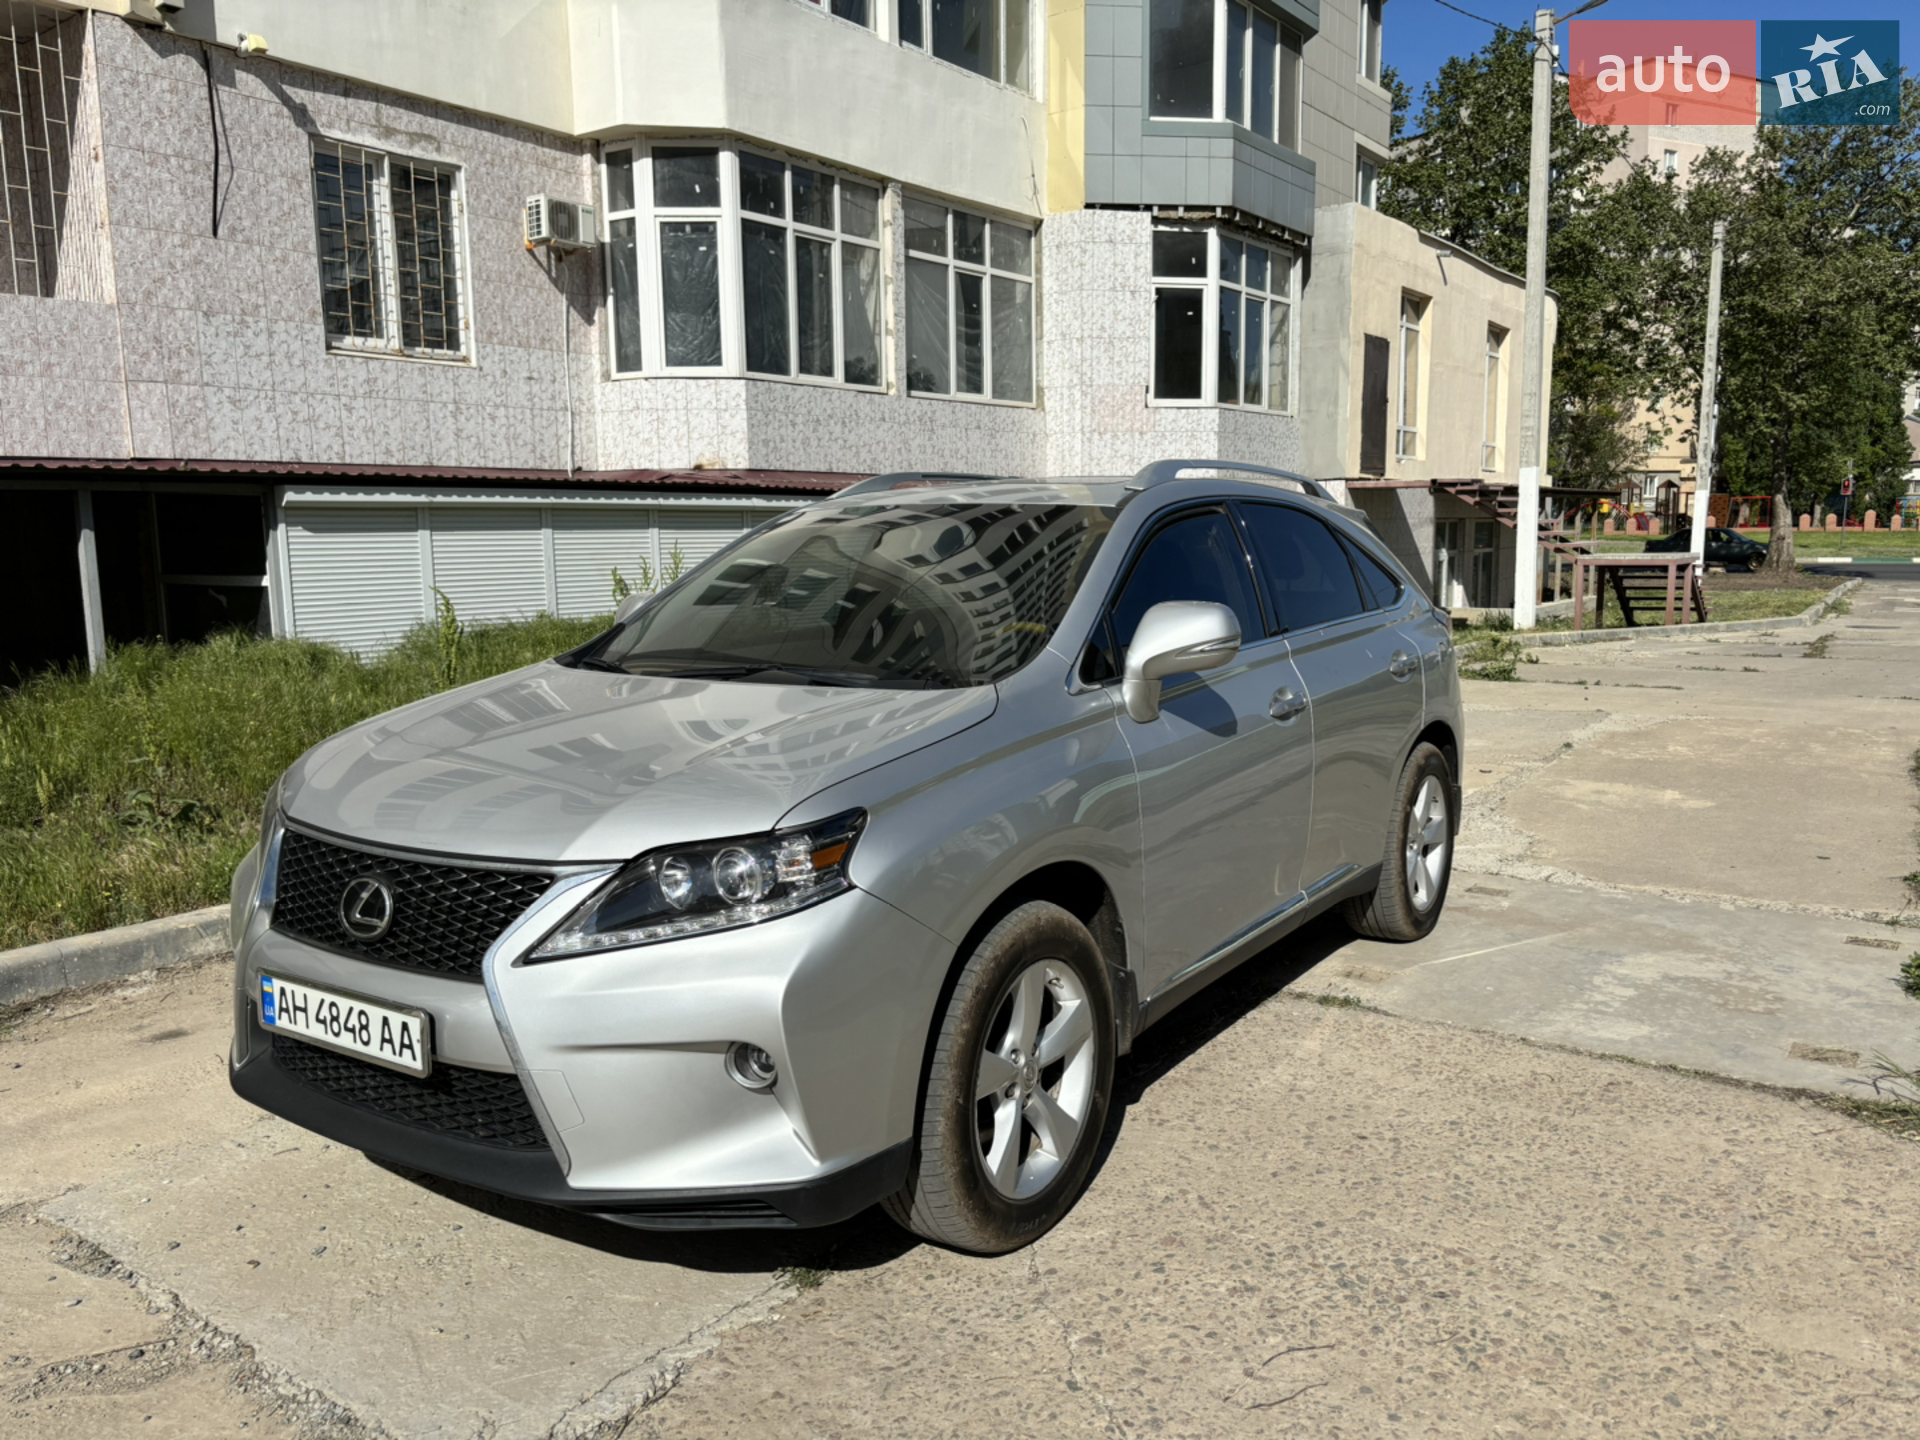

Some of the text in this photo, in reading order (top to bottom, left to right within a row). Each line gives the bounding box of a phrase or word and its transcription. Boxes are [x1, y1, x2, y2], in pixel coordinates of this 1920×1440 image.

[264, 1003, 275, 1017] UA
[278, 986, 418, 1062] AH 4848 AA
